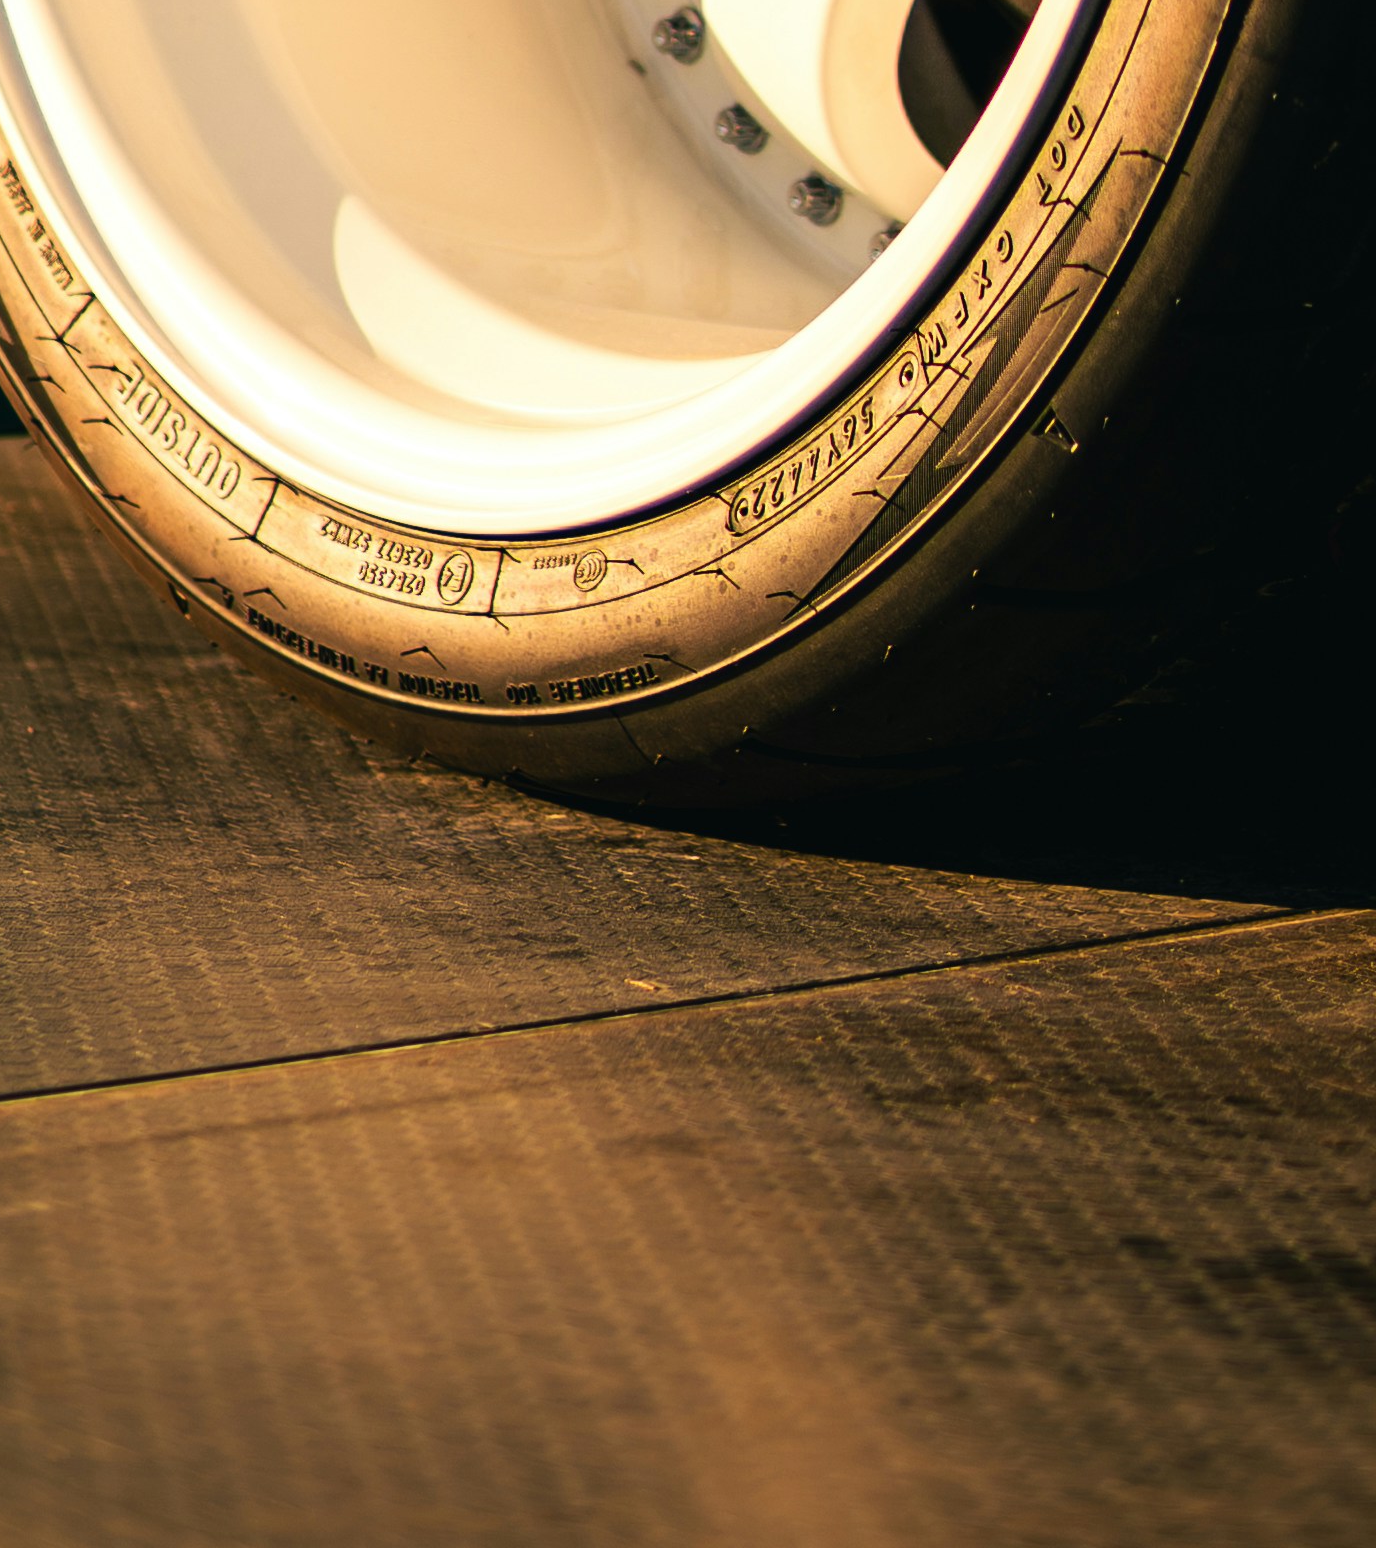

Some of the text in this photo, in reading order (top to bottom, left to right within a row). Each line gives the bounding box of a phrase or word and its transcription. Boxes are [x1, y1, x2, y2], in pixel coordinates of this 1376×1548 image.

[1038, 102, 1086, 207] DOT
[110, 359, 242, 502] OUTSIDE
[547, 660, 661, 706] TREADWEAR
